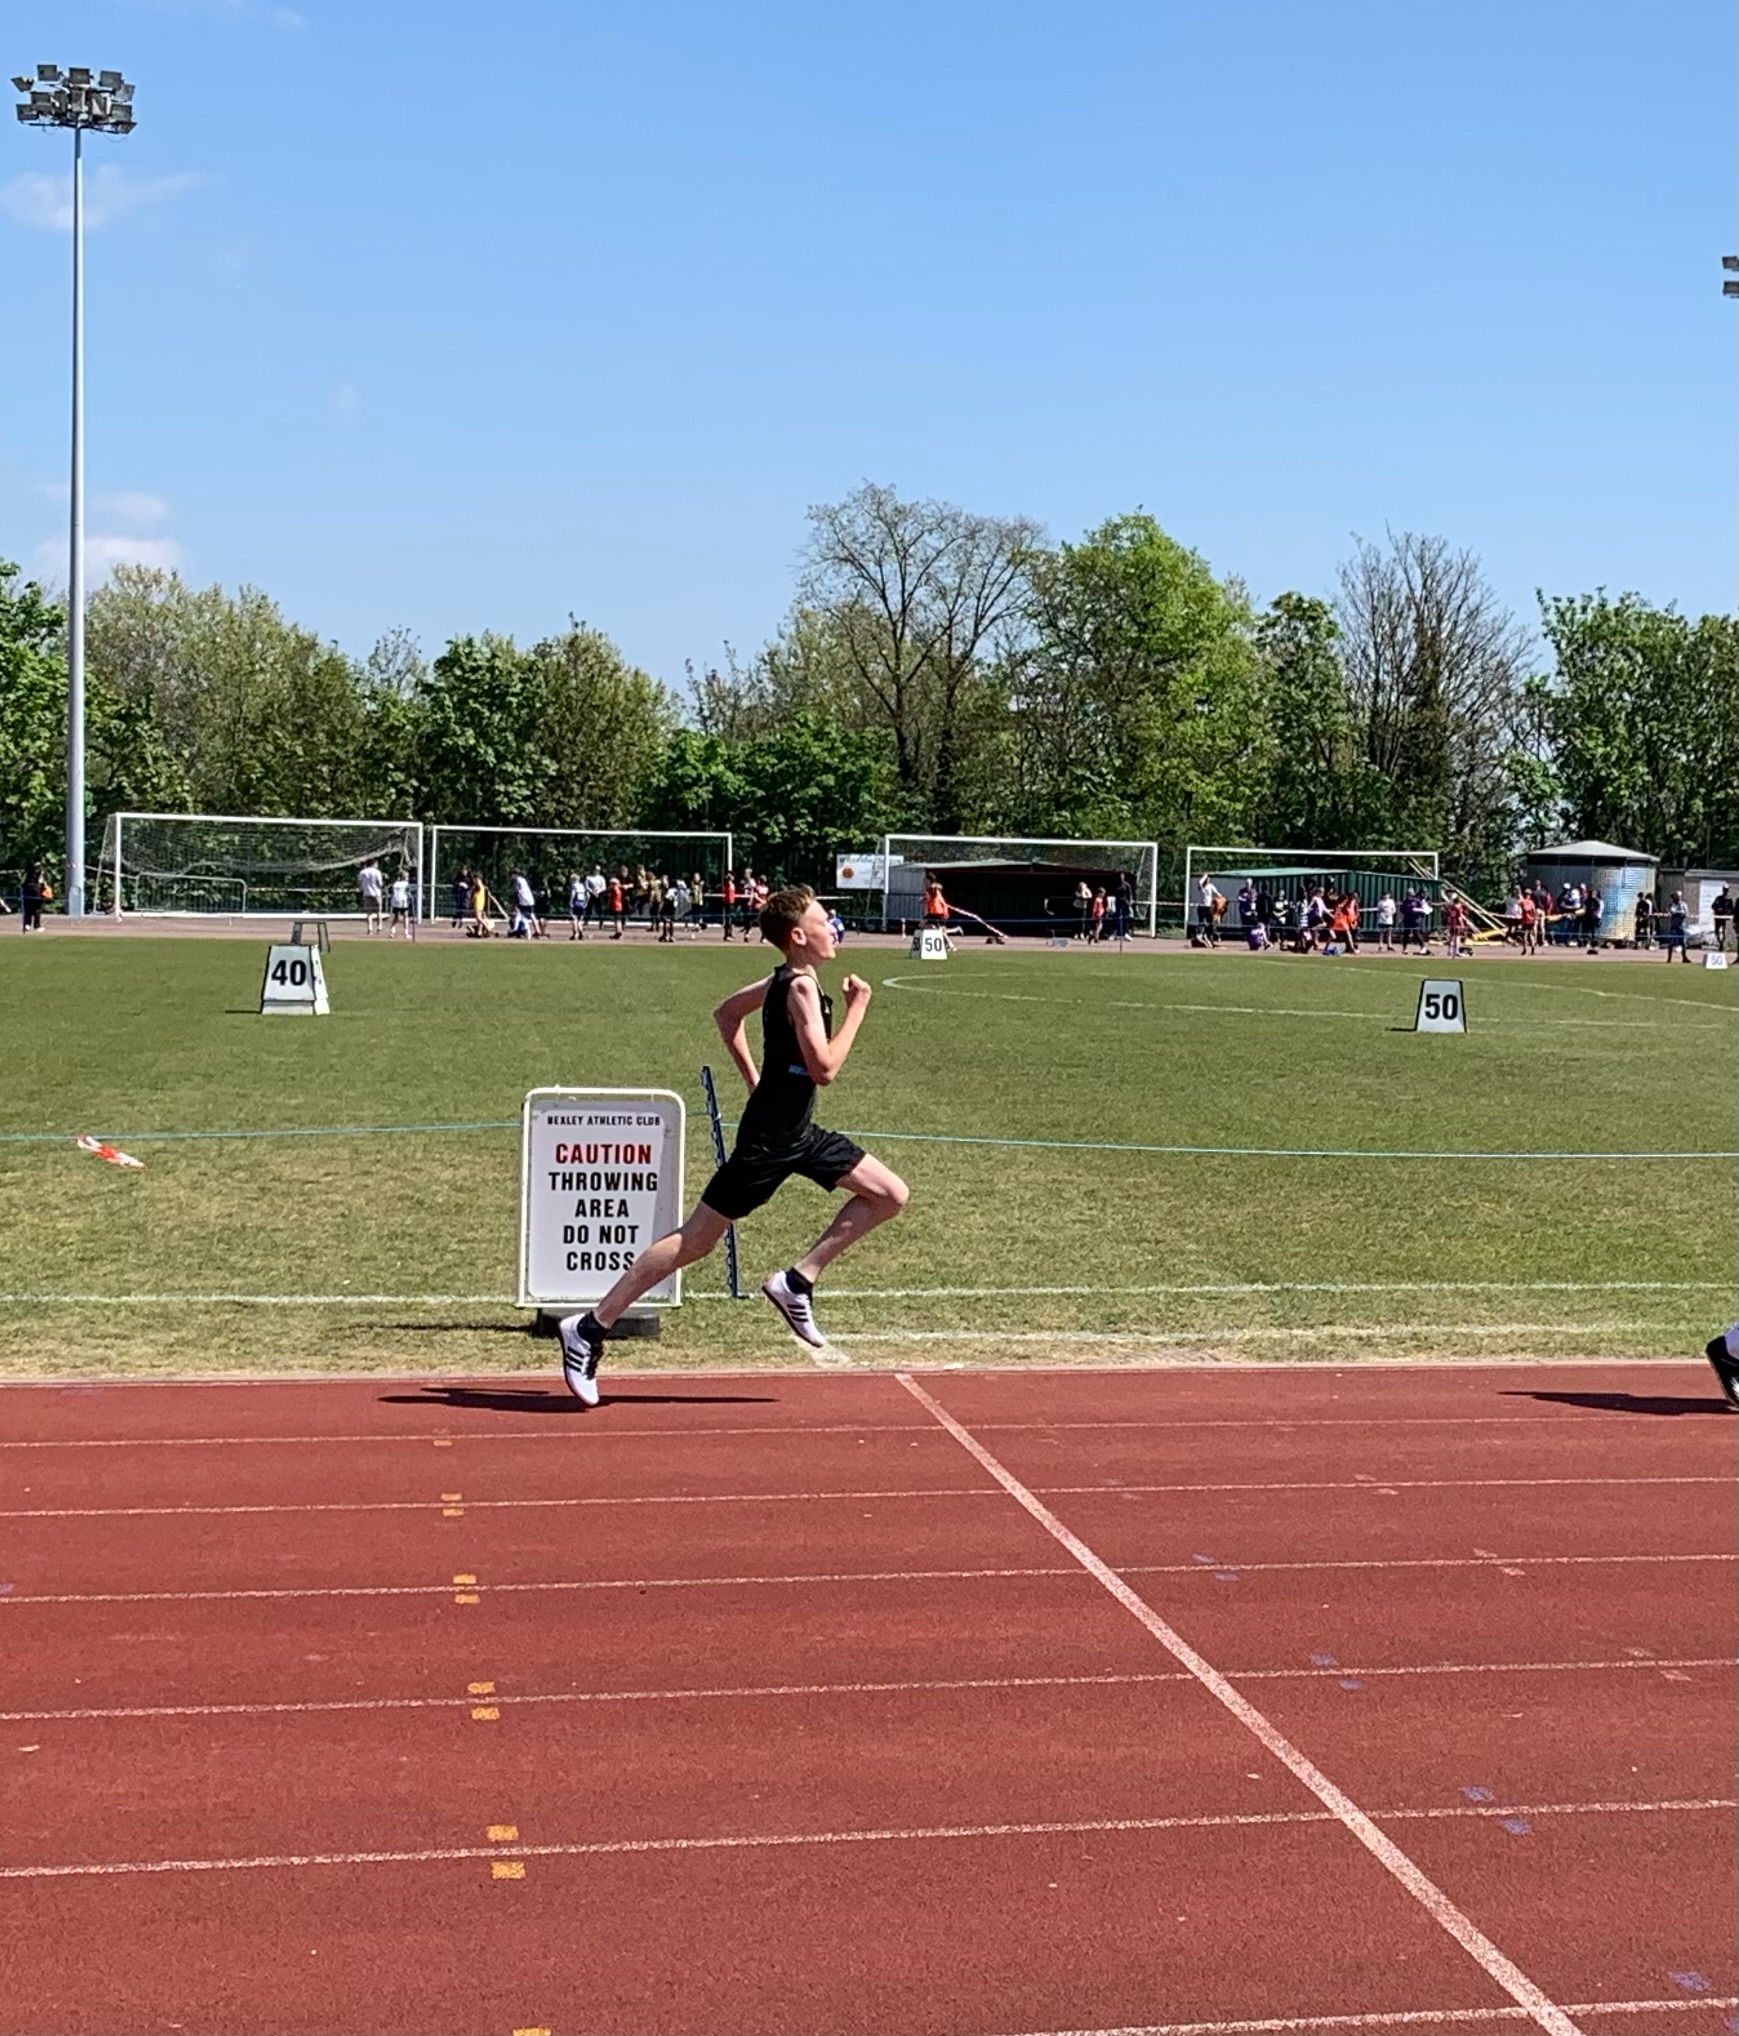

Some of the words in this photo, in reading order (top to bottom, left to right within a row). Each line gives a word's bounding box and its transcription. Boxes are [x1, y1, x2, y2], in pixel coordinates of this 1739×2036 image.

[924, 937, 942, 952] 50
[1711, 955, 1723, 966] 50
[271, 959, 306, 986] 40
[1425, 993, 1458, 1020] 50
[587, 1116, 633, 1126] ATHLETIC
[636, 1116, 661, 1126] CLUB
[556, 1143, 651, 1164] CAUTION
[548, 1172, 658, 1191] THROWING
[575, 1199, 629, 1217] AREA
[563, 1225, 589, 1244] DO
[599, 1225, 640, 1244] NOT
[566, 1252, 635, 1271] CROSS
